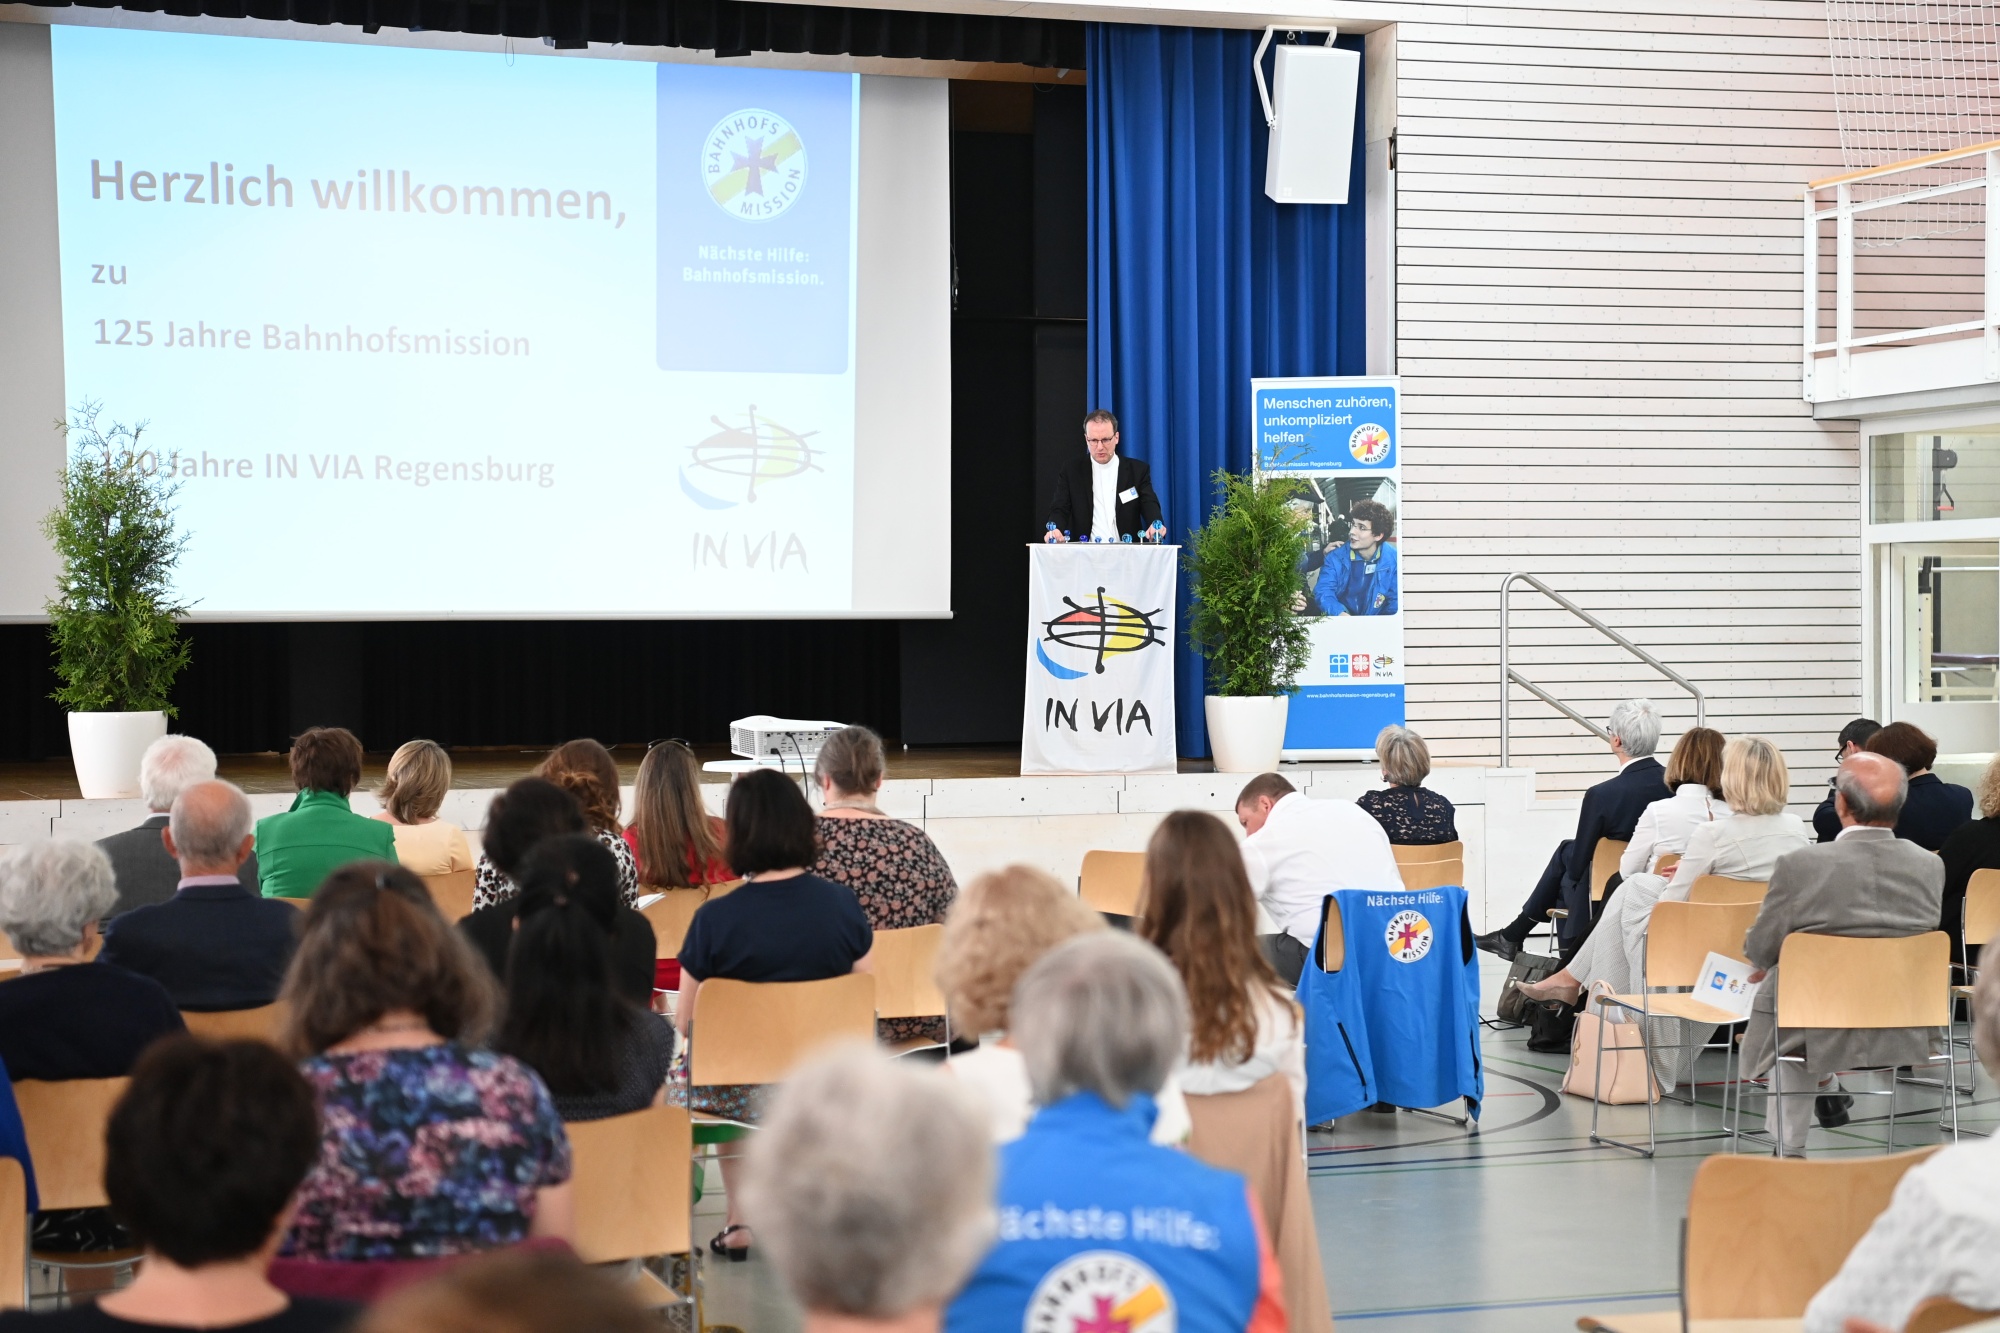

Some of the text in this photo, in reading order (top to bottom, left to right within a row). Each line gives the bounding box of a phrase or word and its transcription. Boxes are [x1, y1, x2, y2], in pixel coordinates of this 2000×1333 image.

[708, 116, 779, 174] BAHNHOFS
[90, 158, 627, 229] Herzlich willkommen,
[740, 168, 801, 216] MISSION
[698, 245, 810, 263] Nächste Hilfe:
[91, 263, 128, 286] zu
[682, 267, 824, 286] Bahnhofsmission.
[94, 318, 531, 358] 125 Jahre Bahnhofsmission
[1263, 396, 1392, 409] Menschen zuhören,
[1264, 414, 1353, 428] unkompliziert
[1264, 431, 1304, 443] helfen
[1351, 425, 1380, 448] BAHNHOFS
[1363, 443, 1389, 463] MISSION
[169, 451, 254, 480] Jahre
[265, 453, 298, 479] IN
[309, 454, 365, 481] VIA
[374, 455, 555, 488] Regensburg
[692, 530, 810, 575] IN VIA
[1045, 698, 1153, 736] IN VIA
[1366, 892, 1444, 907] Nächste Hilfe:
[1388, 913, 1419, 942] BAHNHOFS
[1402, 935, 1429, 960] MISSION
[996, 1202, 1221, 1251] ächste Hilfe:
